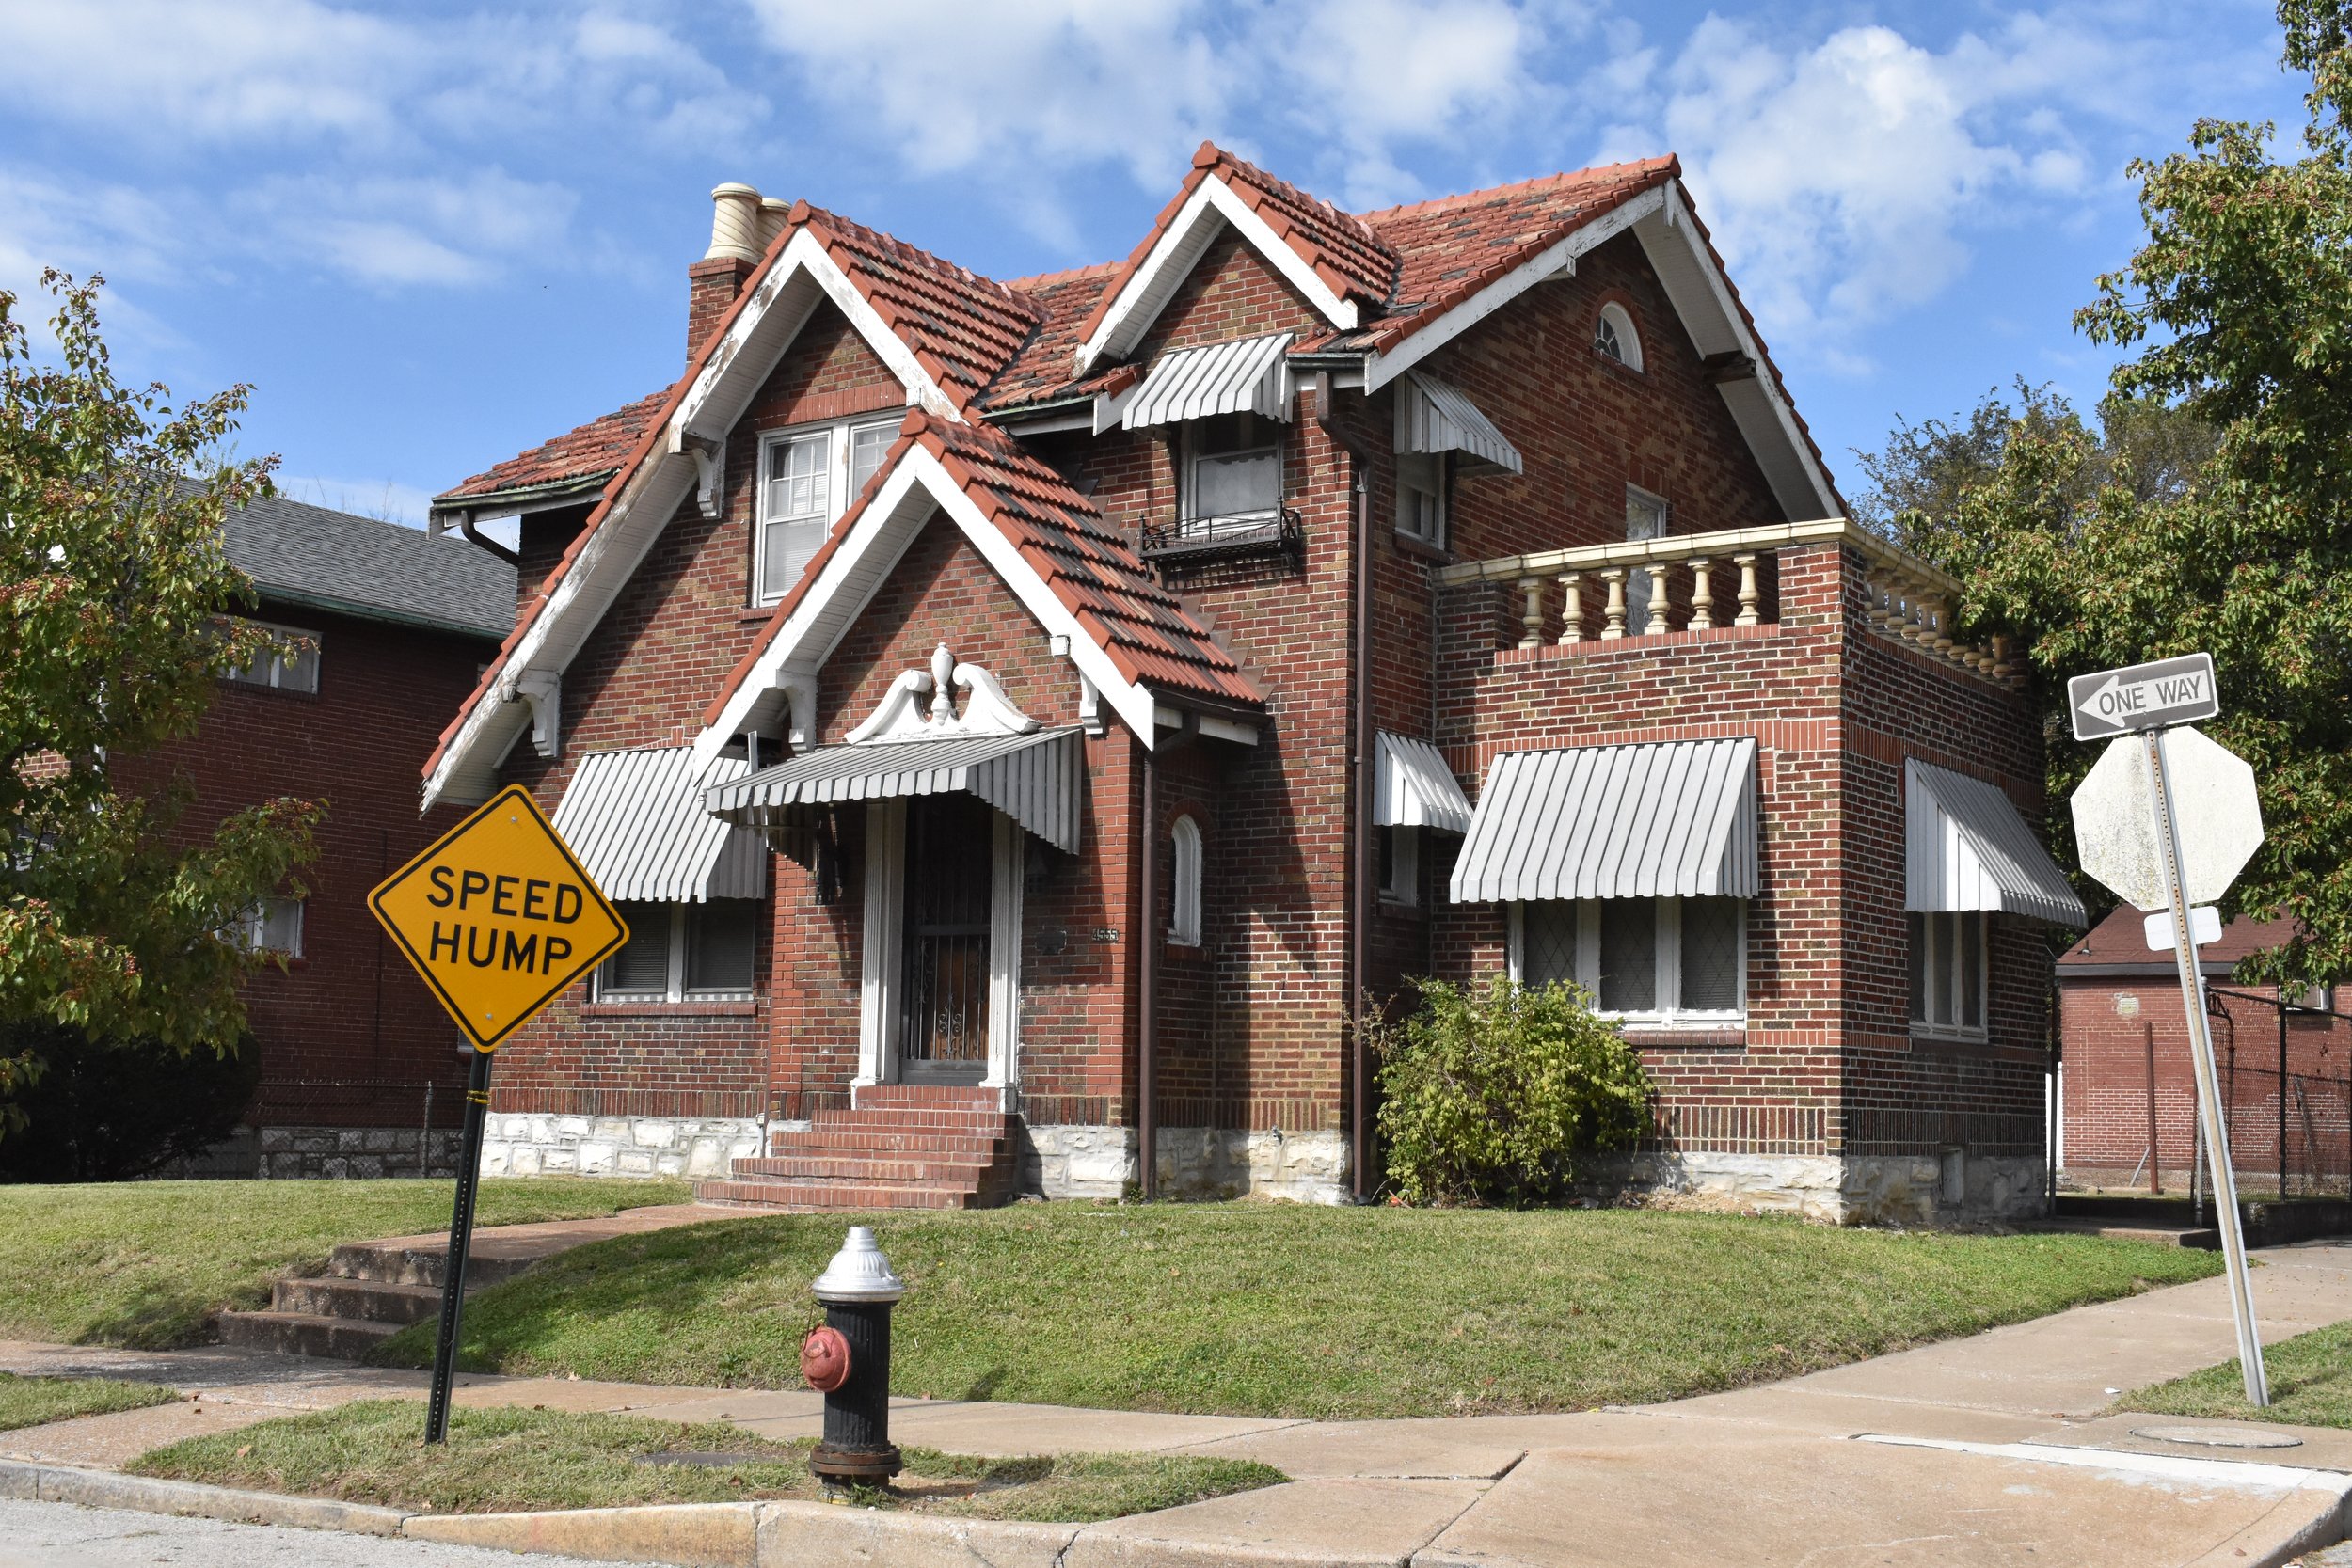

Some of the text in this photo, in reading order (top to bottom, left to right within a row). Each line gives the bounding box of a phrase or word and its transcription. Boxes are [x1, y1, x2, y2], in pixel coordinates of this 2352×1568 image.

[2099, 675, 2201, 715] ONE WAY
[426, 865, 583, 924] SPEED
[429, 921, 573, 975] HUMP
[1092, 928, 1119, 941] 4555
